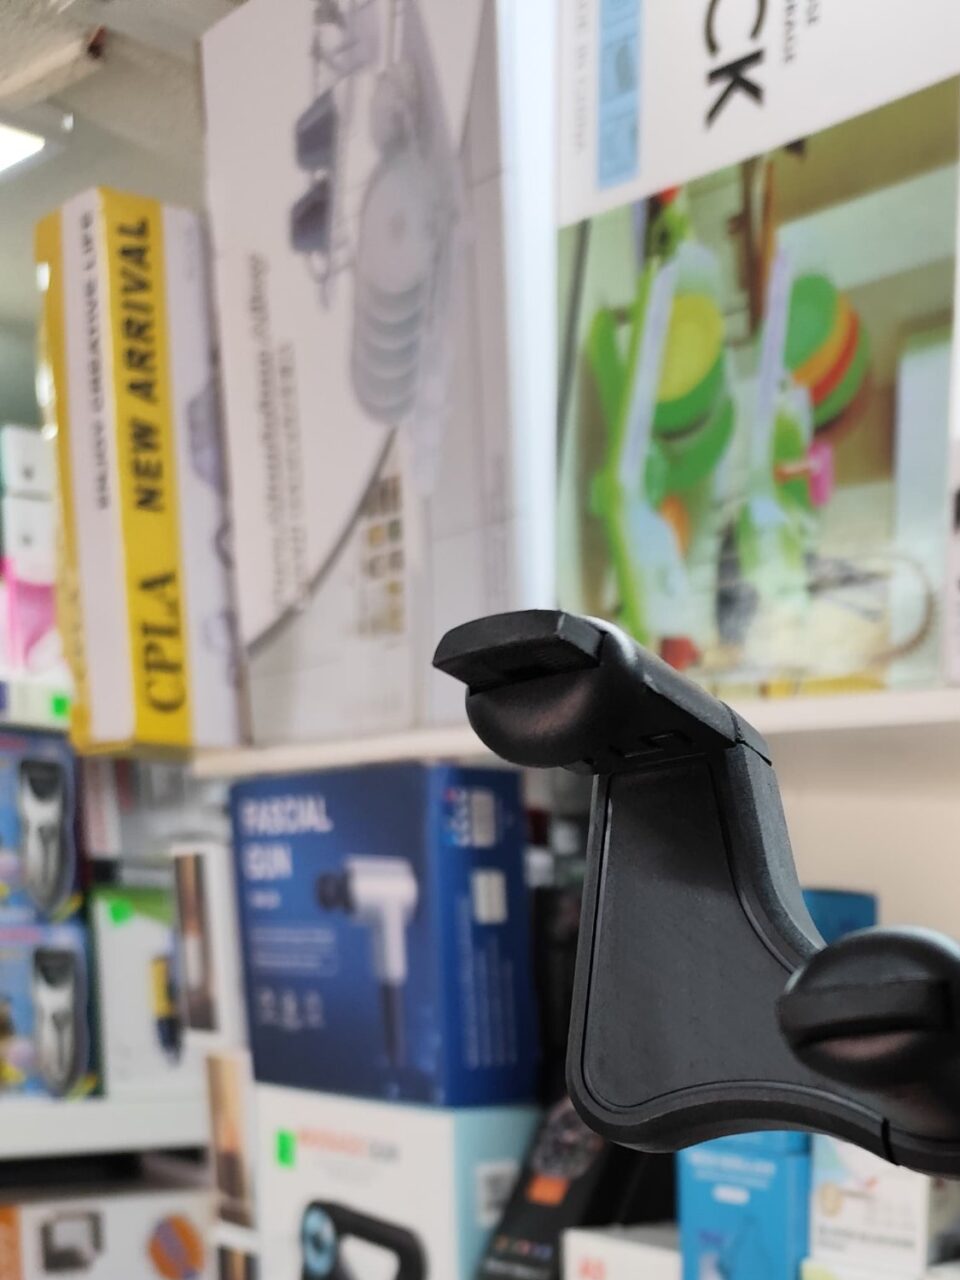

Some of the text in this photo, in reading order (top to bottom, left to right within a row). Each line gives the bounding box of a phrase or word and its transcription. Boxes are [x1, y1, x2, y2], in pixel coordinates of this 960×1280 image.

[117, 216, 165, 513] NEW ARRIVAL
[138, 570, 187, 713] CPLA
